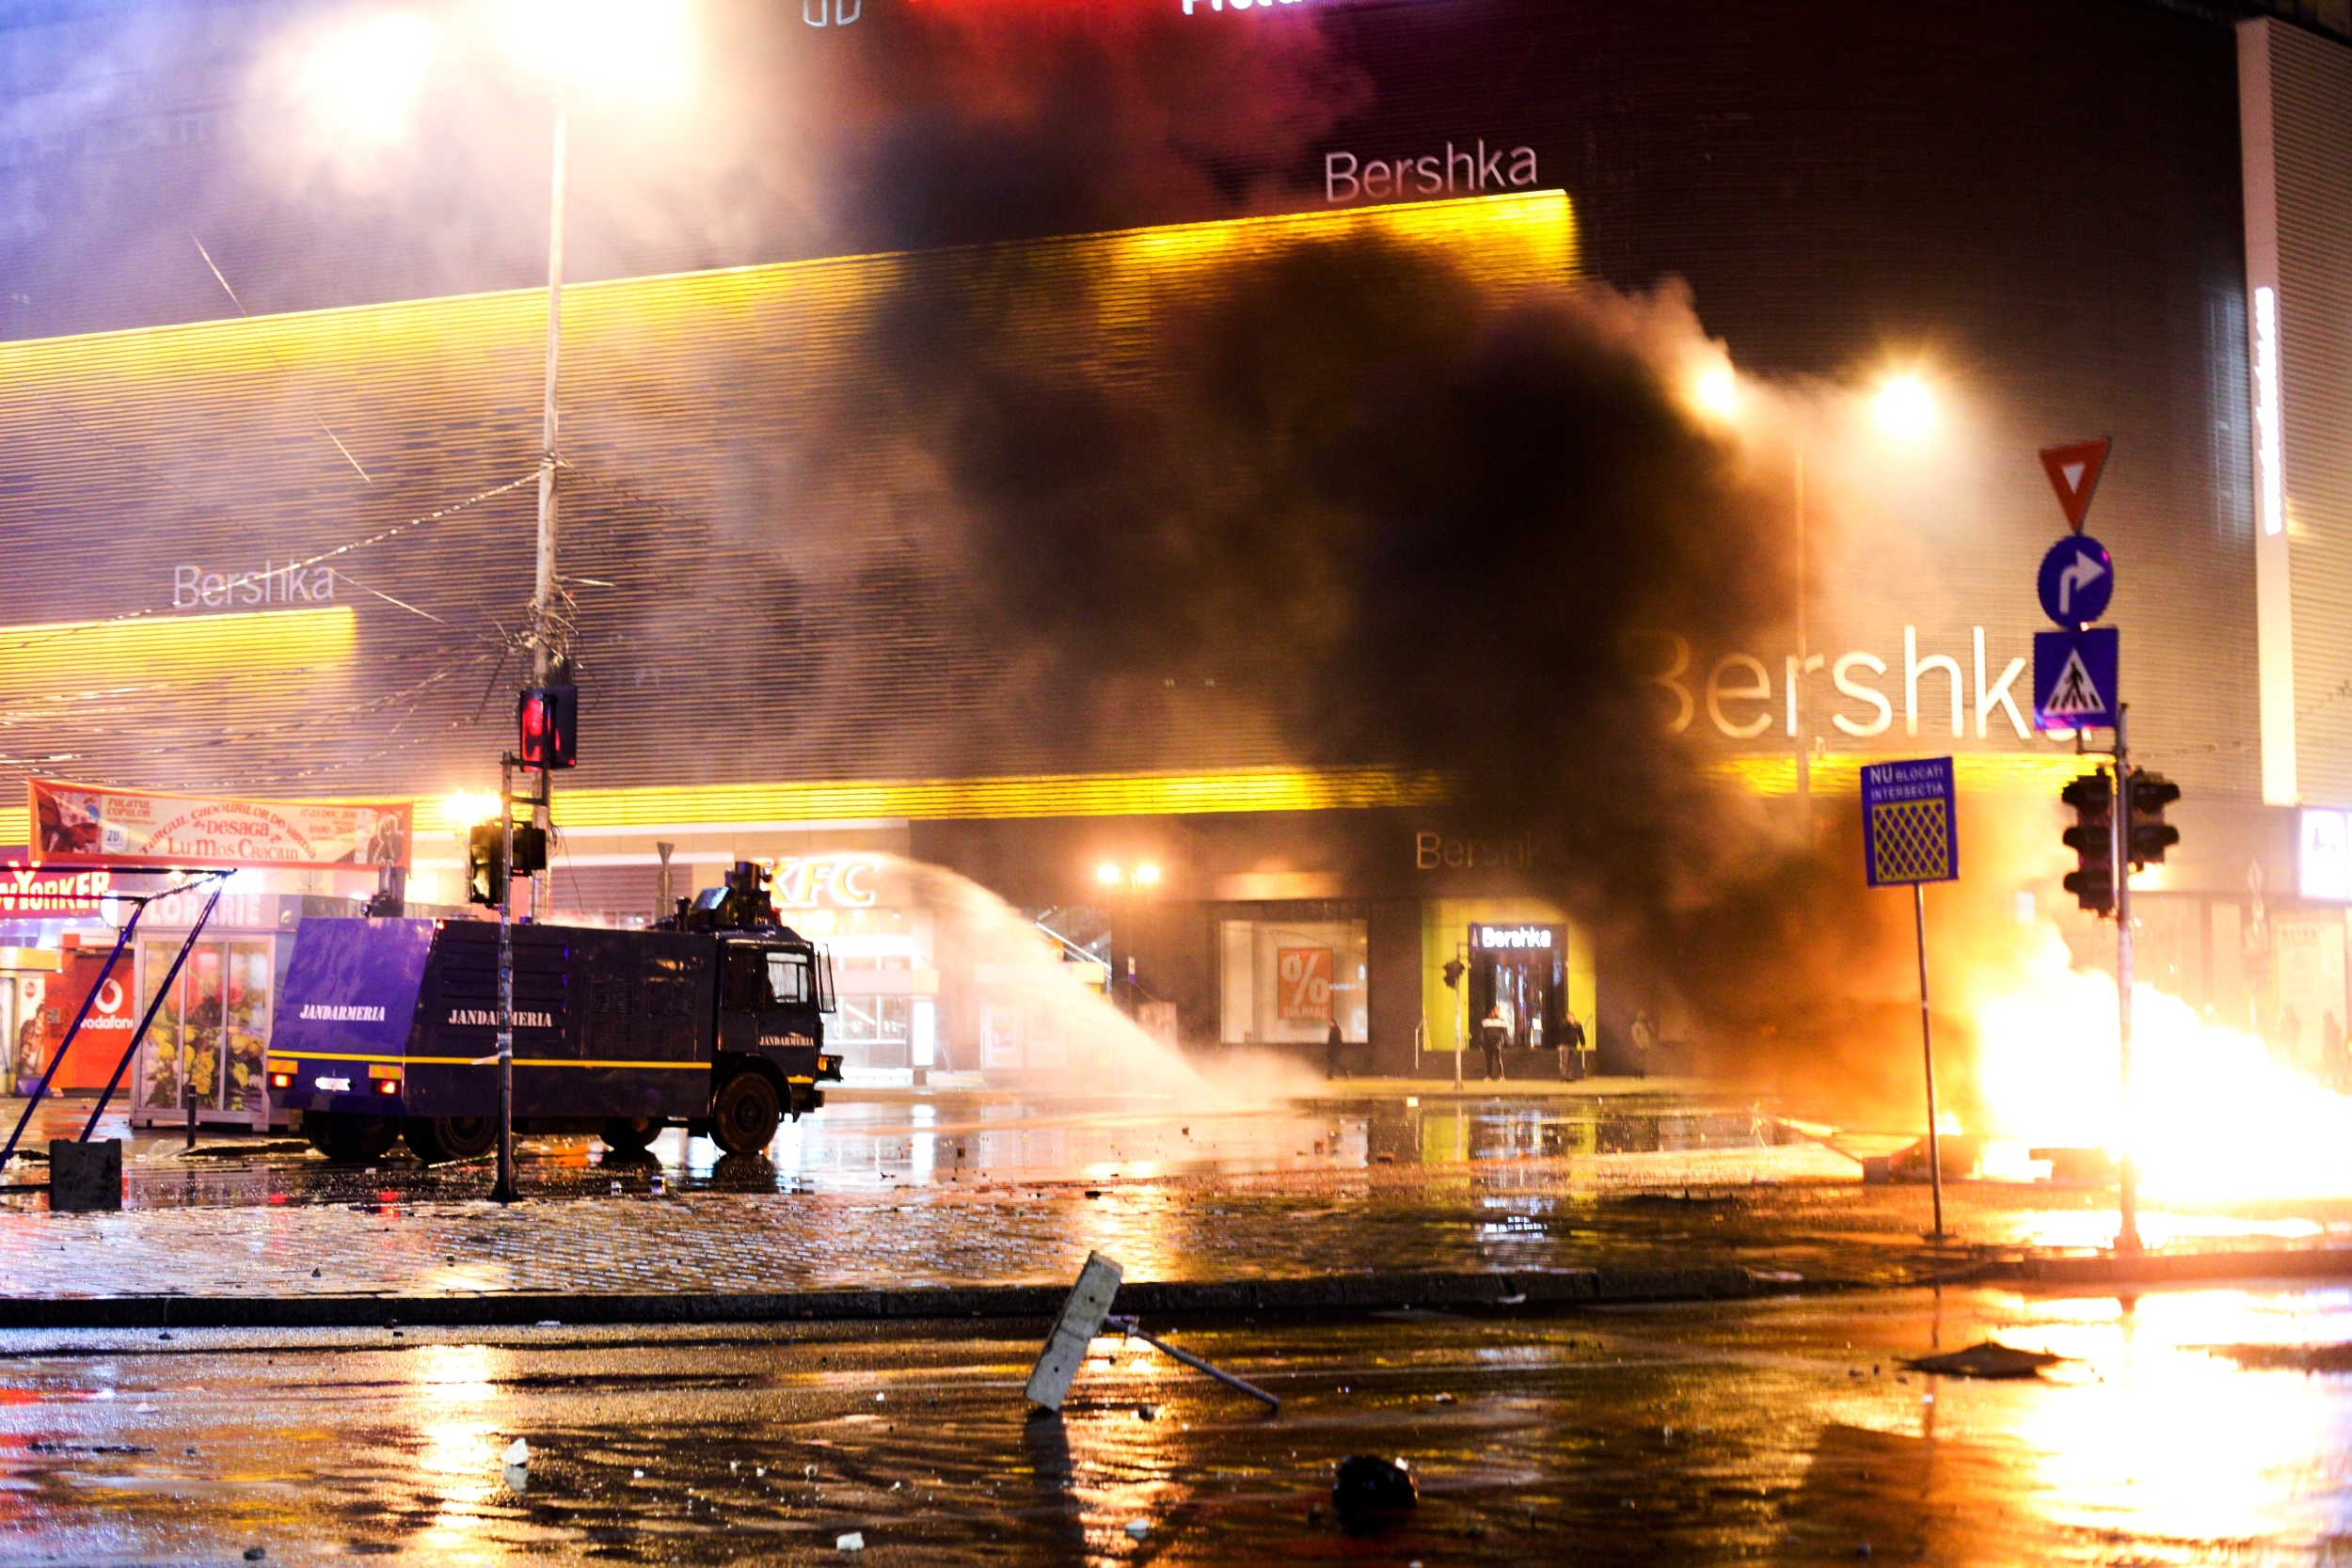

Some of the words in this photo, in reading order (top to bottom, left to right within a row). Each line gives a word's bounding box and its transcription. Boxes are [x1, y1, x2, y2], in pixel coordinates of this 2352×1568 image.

[1326, 137, 1538, 202] Bershka
[173, 558, 334, 608] Bershka
[1629, 625, 2092, 741] Bershk
[1869, 765, 1893, 784] NU
[752, 855, 882, 908] KFC
[1482, 927, 1551, 948] Bershka
[299, 1004, 386, 1022] JANDARMERIA
[759, 1036, 815, 1047] JANDARMERIA
